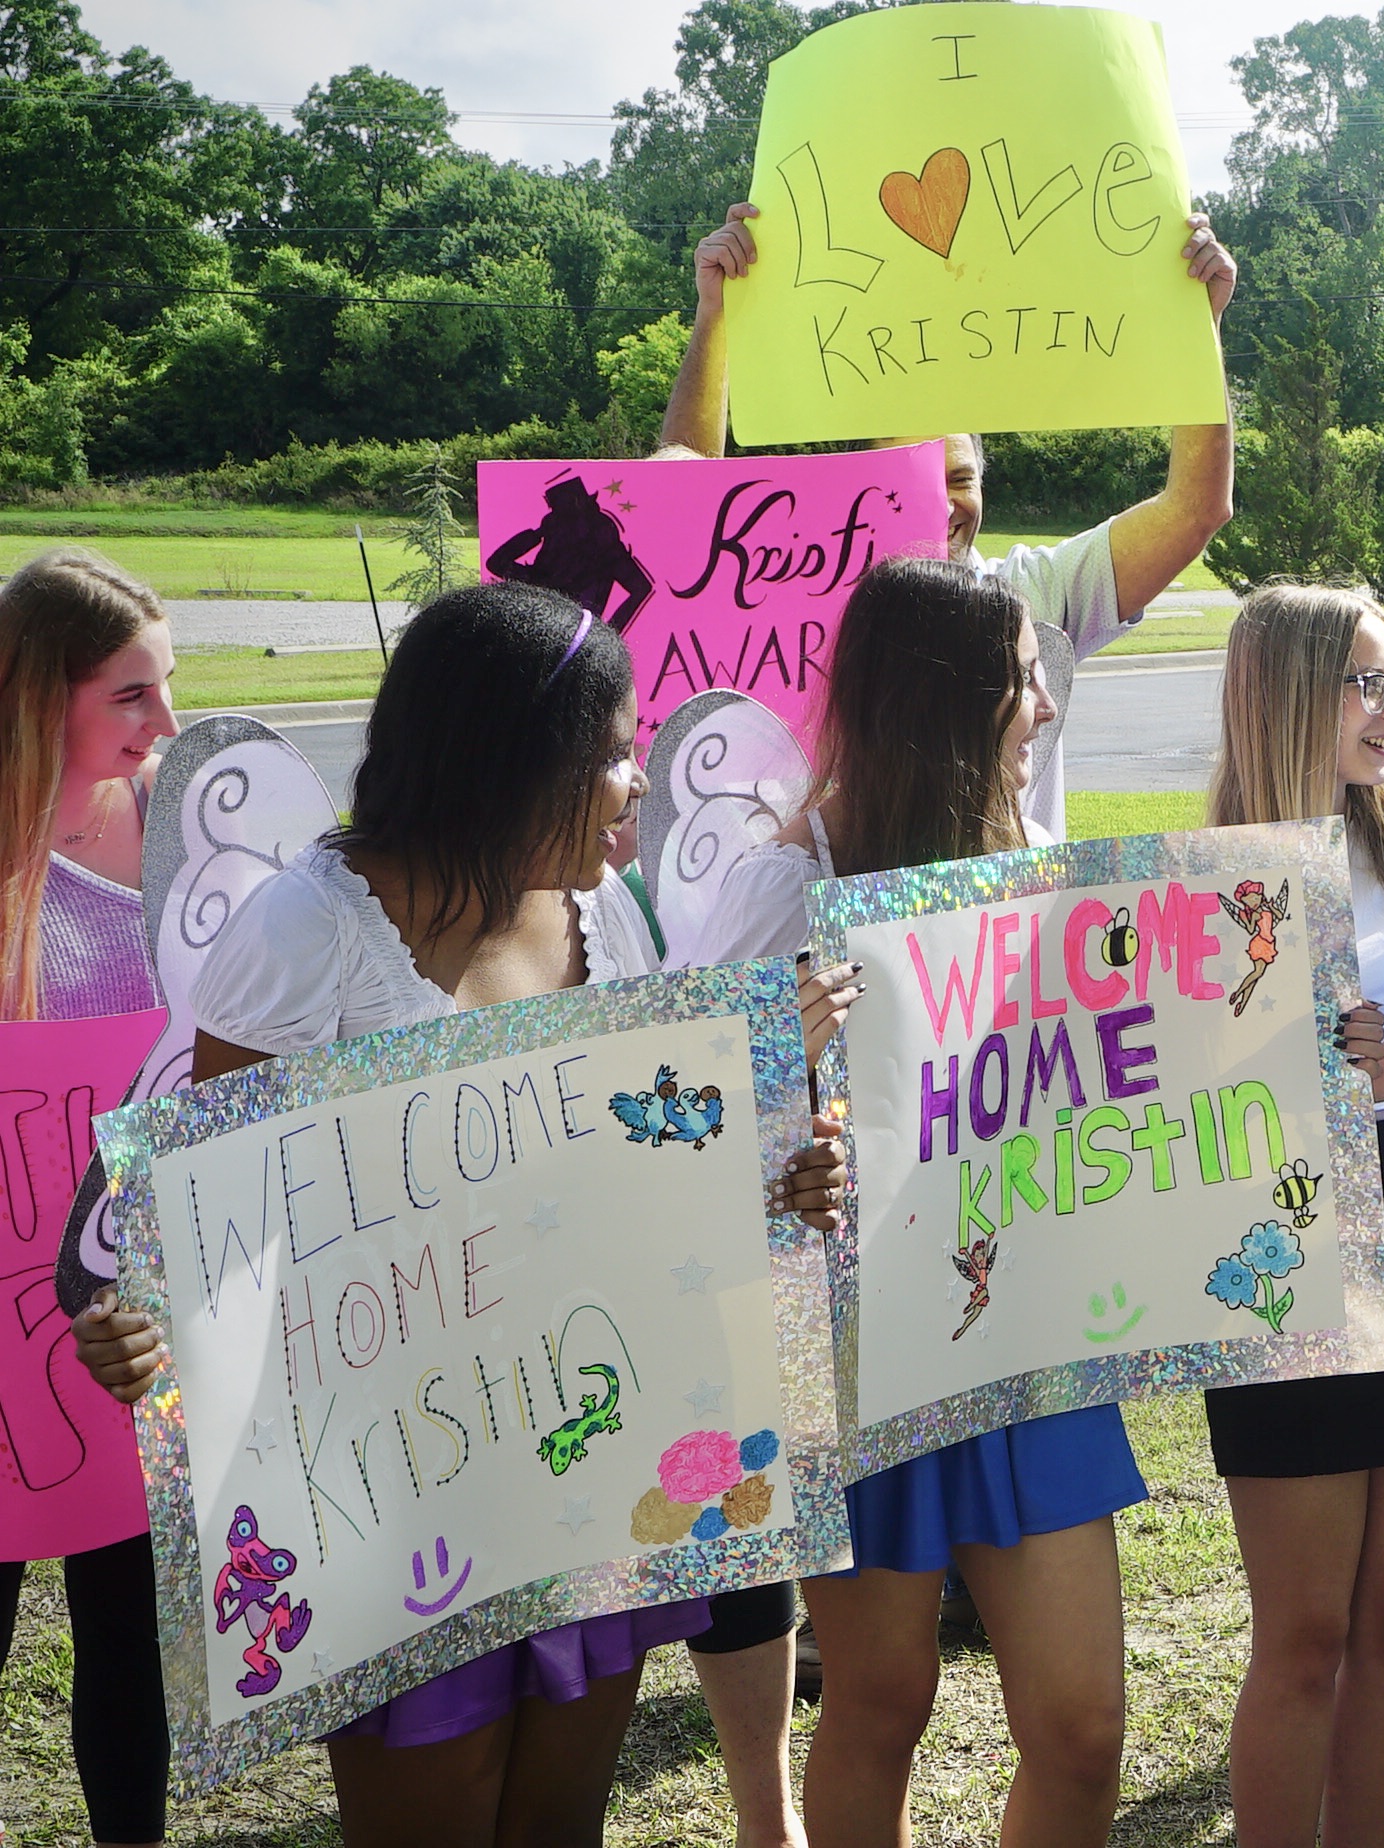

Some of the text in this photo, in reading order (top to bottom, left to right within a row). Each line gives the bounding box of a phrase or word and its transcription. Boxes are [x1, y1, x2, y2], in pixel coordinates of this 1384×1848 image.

[931, 34, 979, 81] I
[776, 138, 1161, 293] LVe
[813, 306, 1126, 397] KRISTIN
[664, 478, 876, 610] Kristi
[648, 620, 831, 704] AWAR
[905, 881, 1225, 1049] WELCME
[918, 1001, 1161, 1164] HOME
[185, 1054, 597, 1326] WELCOME
[280, 1225, 505, 1397] HOME
